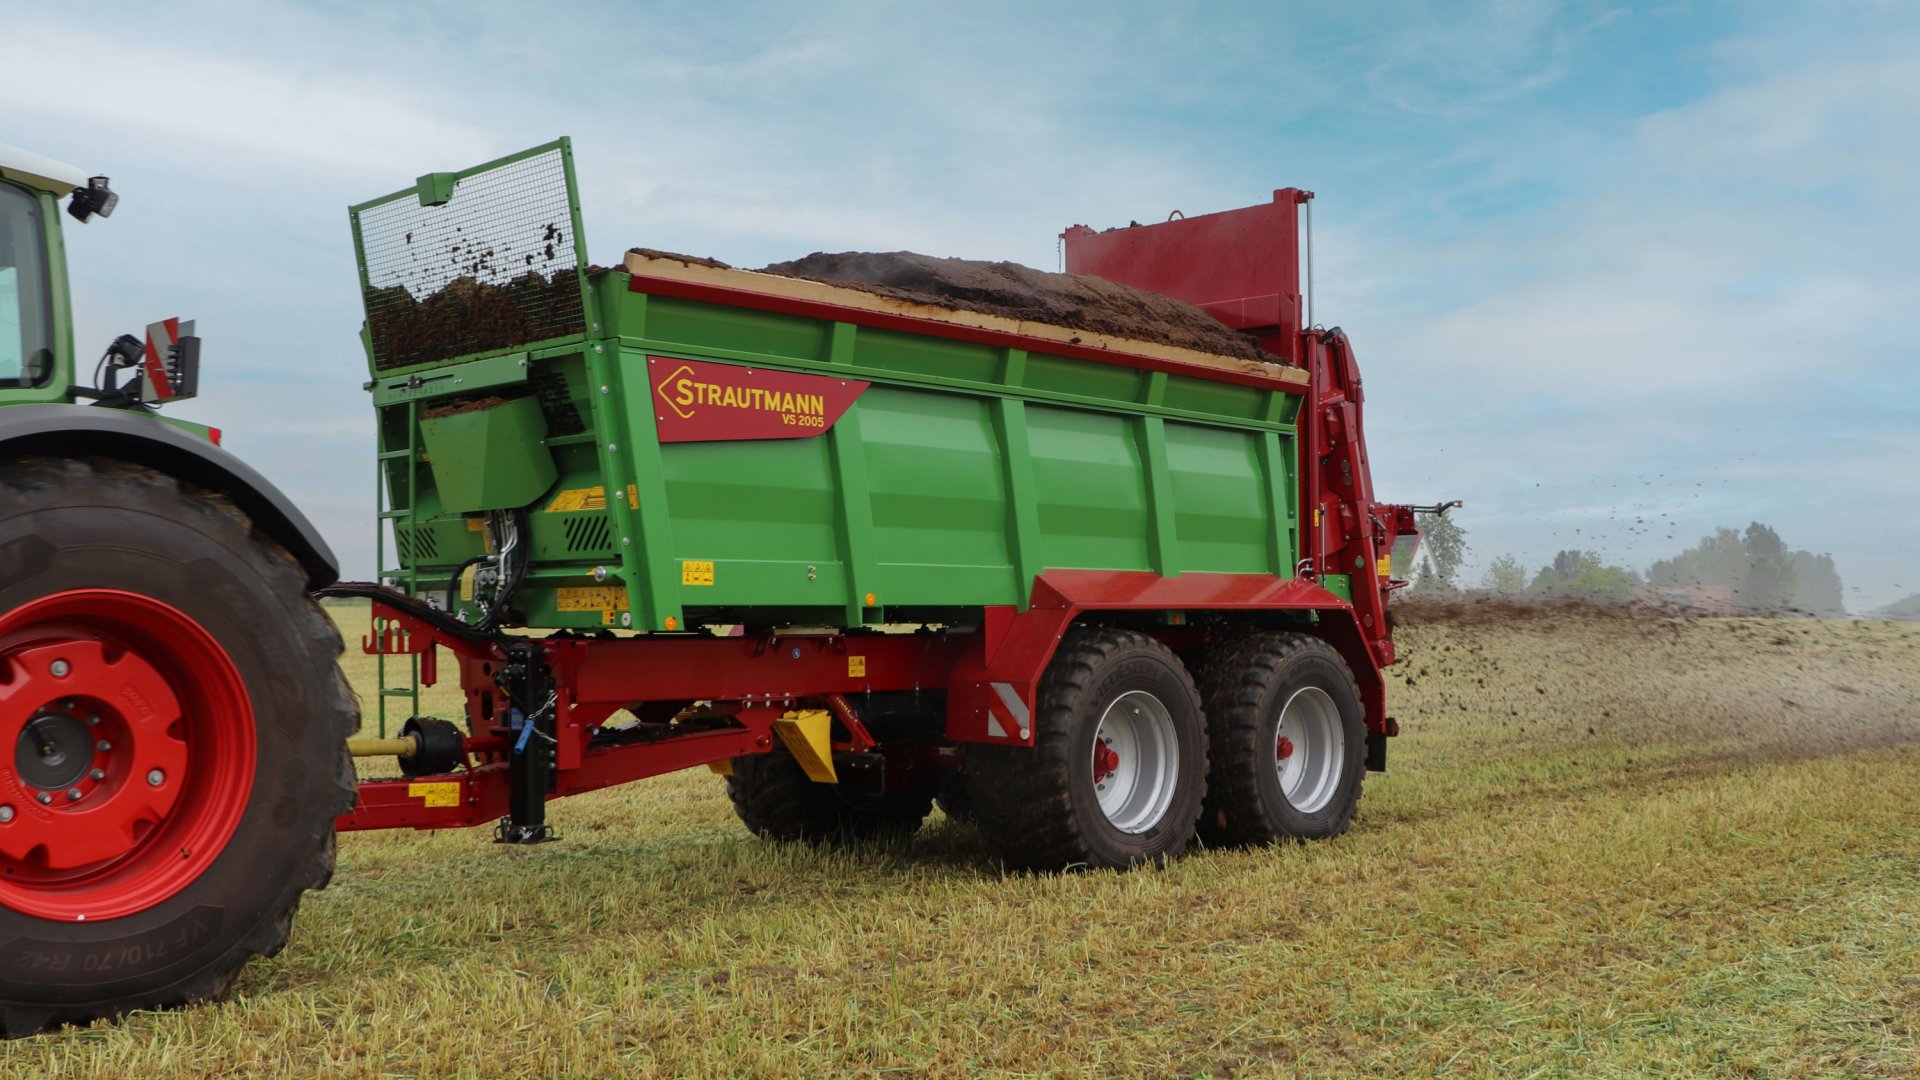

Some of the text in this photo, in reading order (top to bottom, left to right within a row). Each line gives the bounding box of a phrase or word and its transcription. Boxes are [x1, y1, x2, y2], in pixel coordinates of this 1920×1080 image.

[675, 378, 824, 416] STRAUTMANN
[782, 413, 825, 428] VS 2005
[15, 919, 208, 972] VF 710/70 R42
